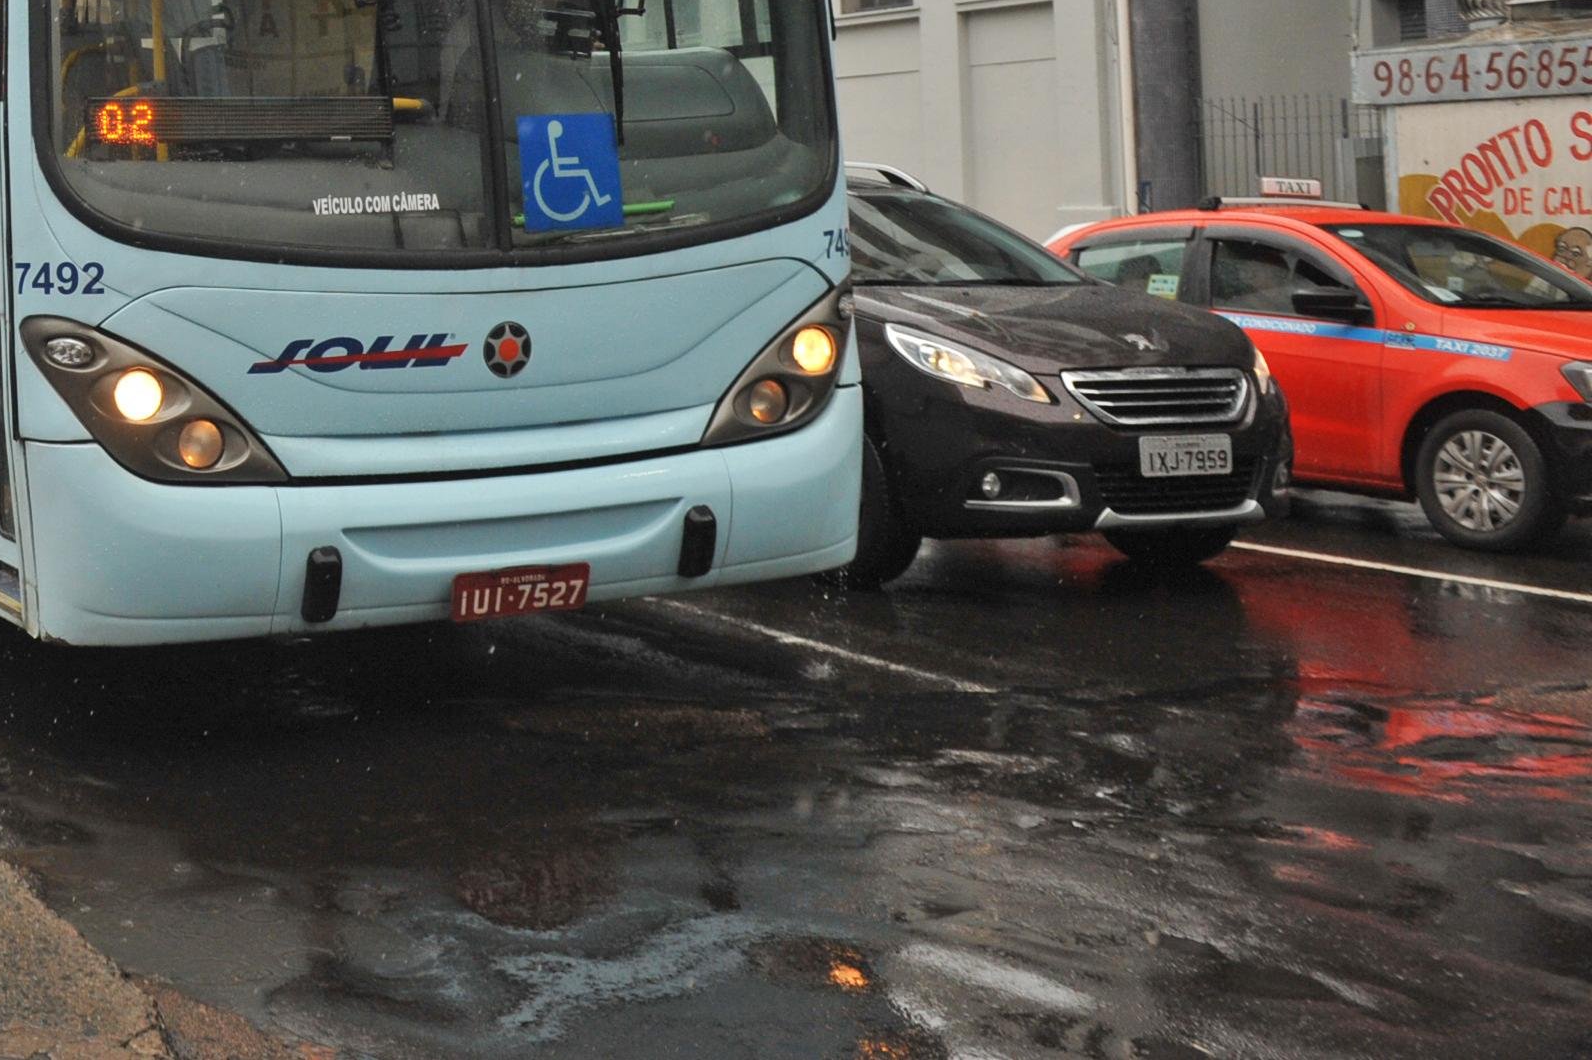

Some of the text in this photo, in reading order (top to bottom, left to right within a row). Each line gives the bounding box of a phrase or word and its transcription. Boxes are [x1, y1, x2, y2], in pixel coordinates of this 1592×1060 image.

[102, 103, 153, 141] 02
[1427, 117, 1554, 226] PRONTO
[1275, 180, 1314, 195] TAXI
[1503, 187, 1533, 216] DE
[312, 191, 440, 215] VEÍCULO COM CÂMERA
[14, 262, 105, 295] 7492
[1435, 338, 1469, 353] TAXI
